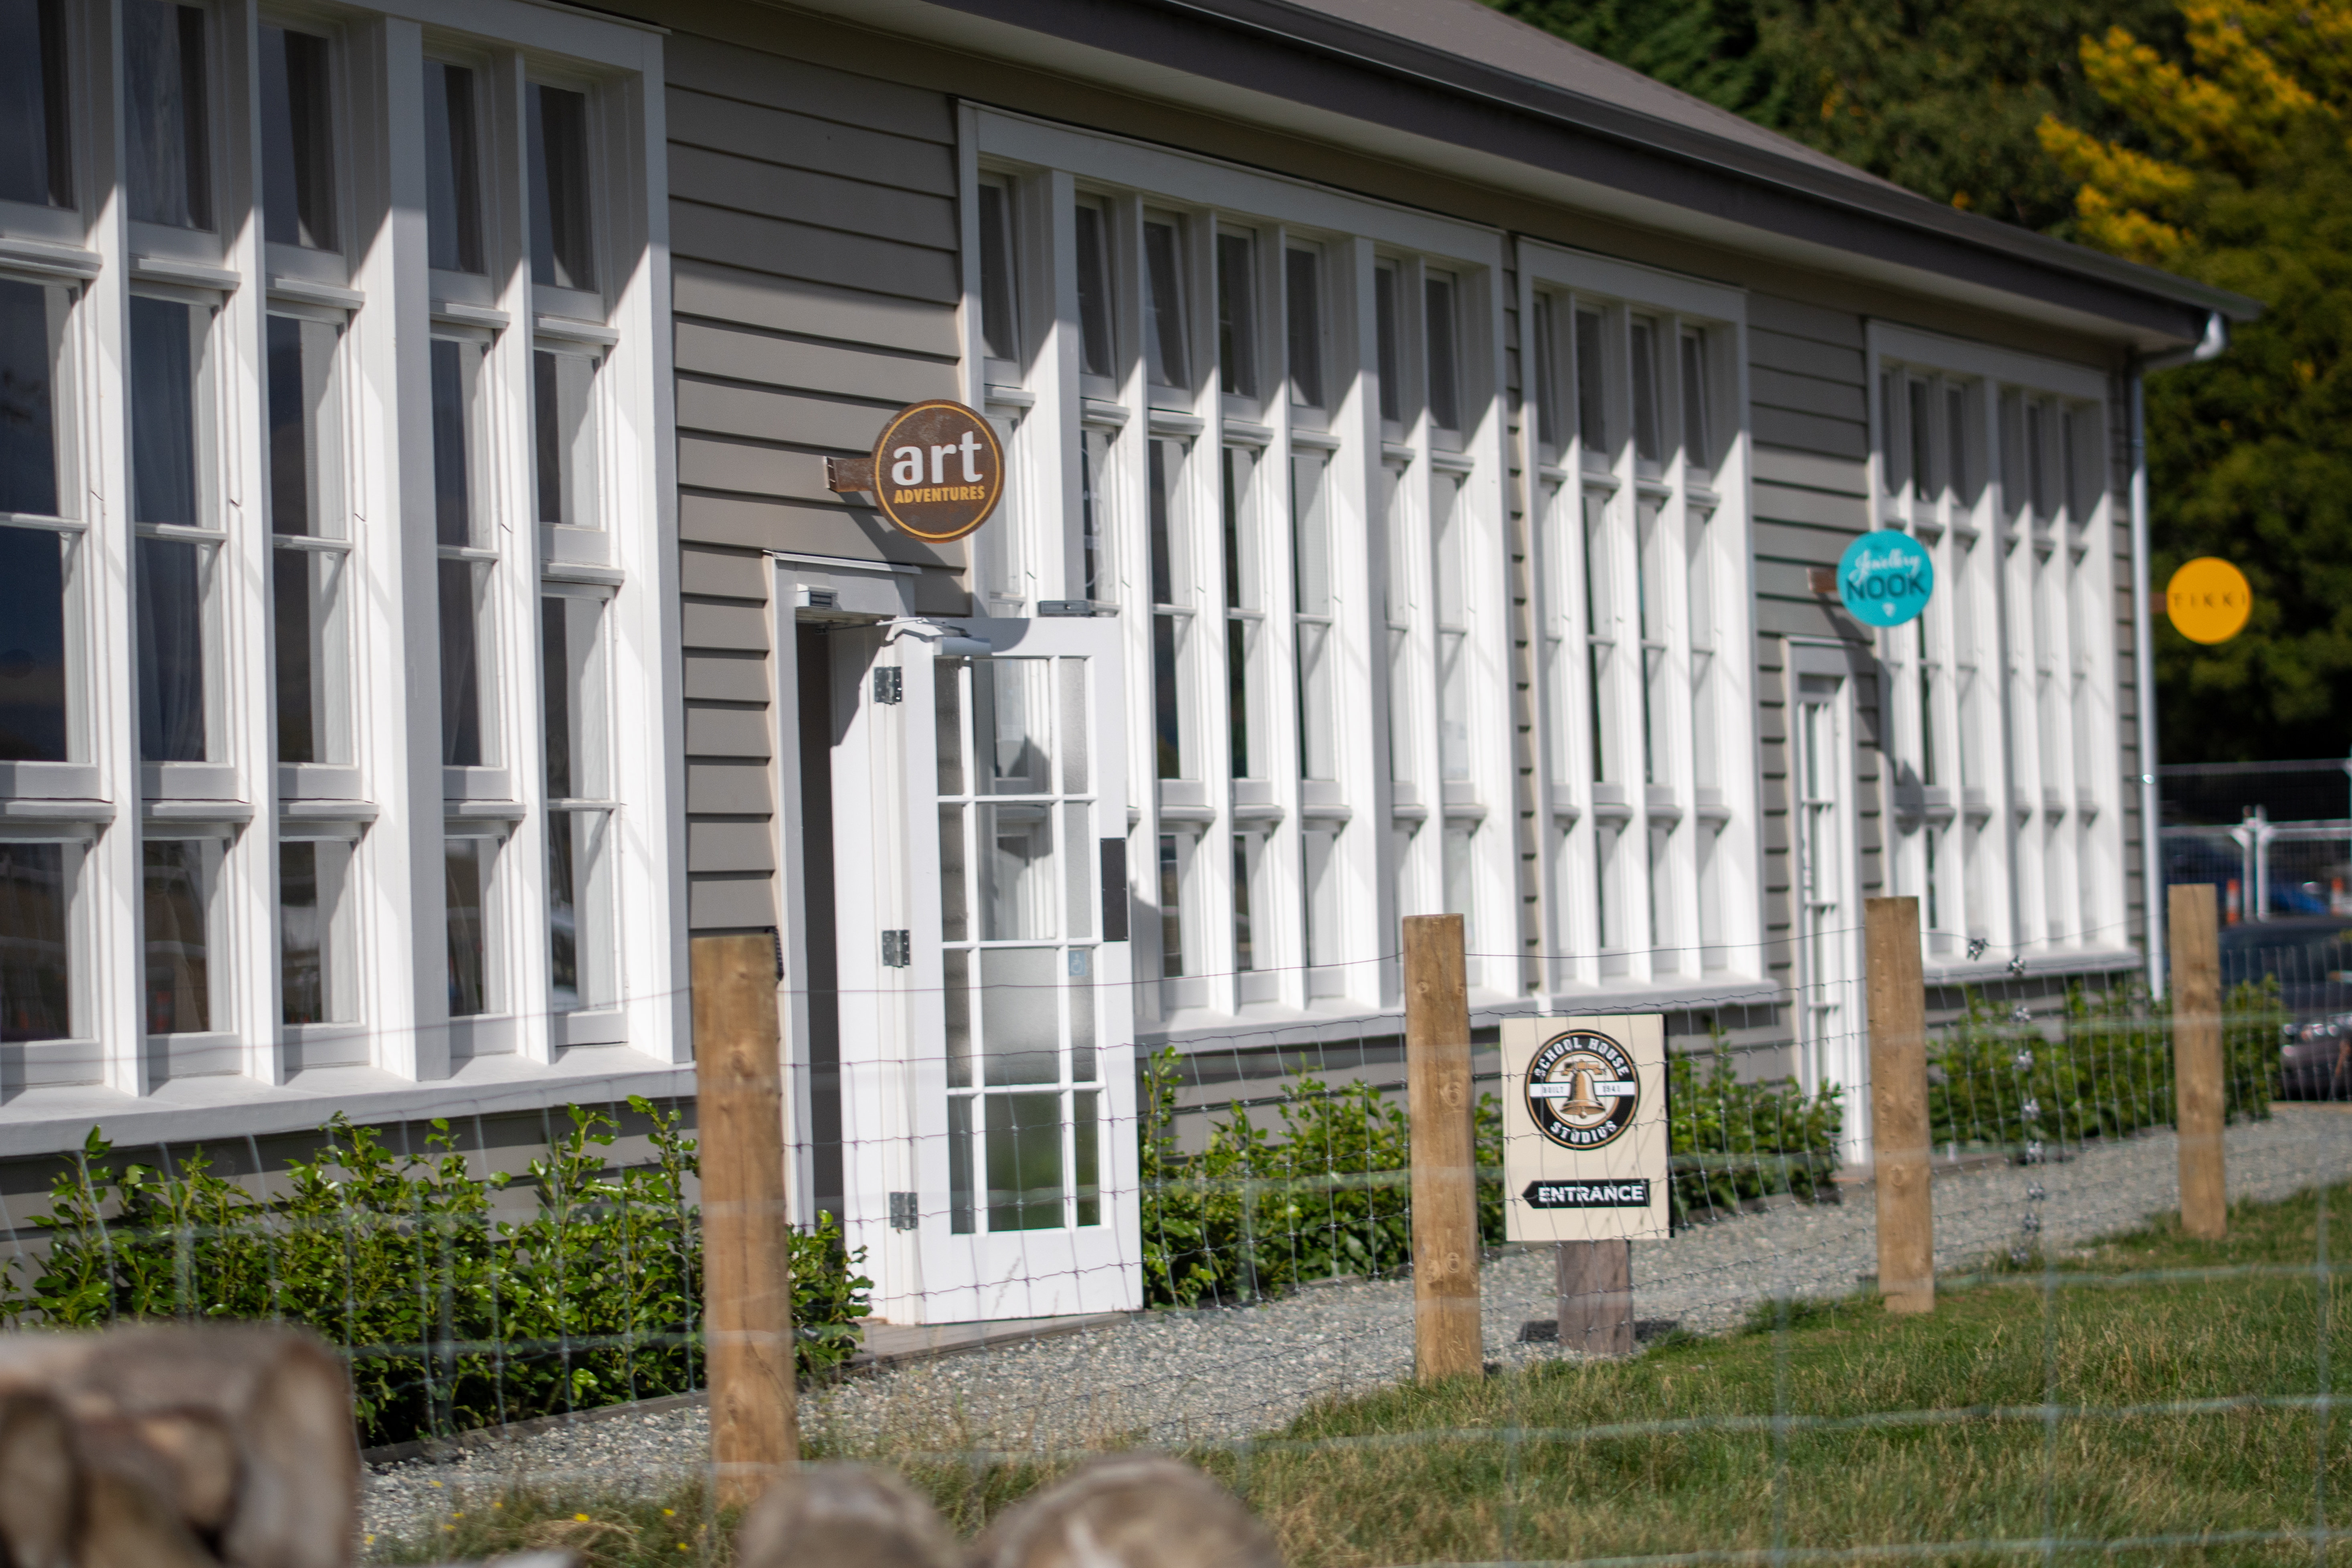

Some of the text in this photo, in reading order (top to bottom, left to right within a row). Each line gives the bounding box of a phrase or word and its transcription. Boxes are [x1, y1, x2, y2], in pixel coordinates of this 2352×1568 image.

[892, 431, 983, 486] art
[894, 486, 985, 504] ADVENTURES
[1846, 571, 1925, 600] NOOK
[1534, 1037, 1630, 1077] SCHOOL HOUSE
[1550, 1121, 1617, 1143] STUDIOS
[1538, 1185, 1644, 1202] ENTRANCE
